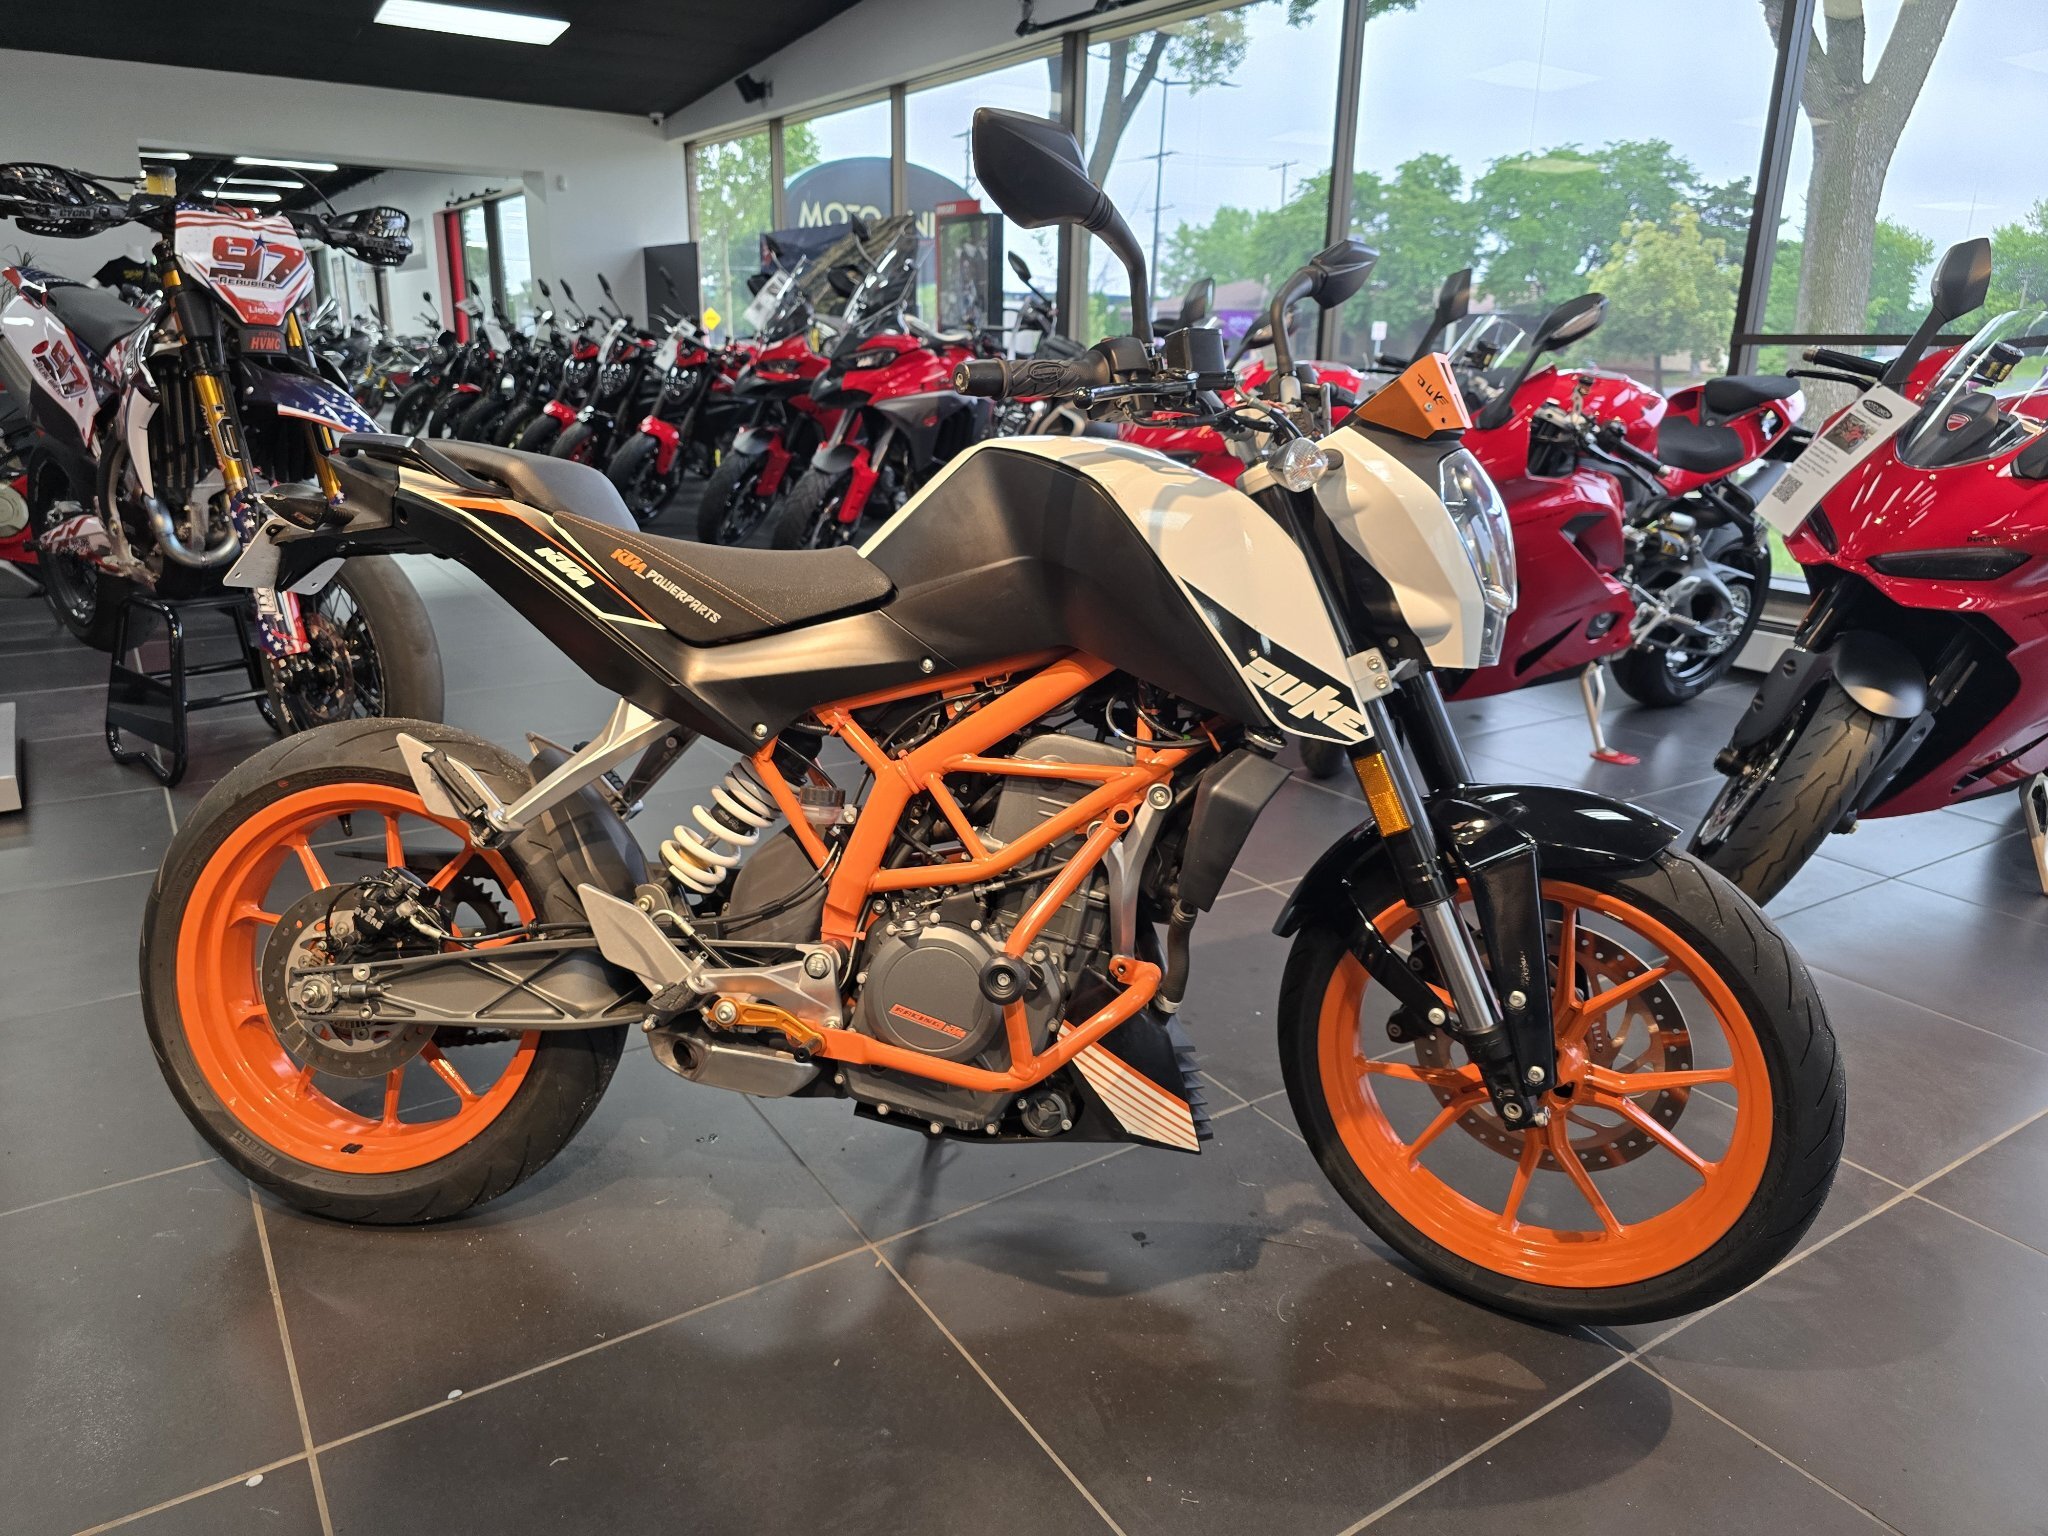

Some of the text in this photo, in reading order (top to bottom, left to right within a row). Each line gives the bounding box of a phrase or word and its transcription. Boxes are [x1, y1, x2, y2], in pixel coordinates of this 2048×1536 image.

[209, 235, 305, 287] 97
[250, 336, 281, 350] HVMC
[534, 547, 596, 589] KTM
[610, 548, 722, 625] KTM POWERPARTS
